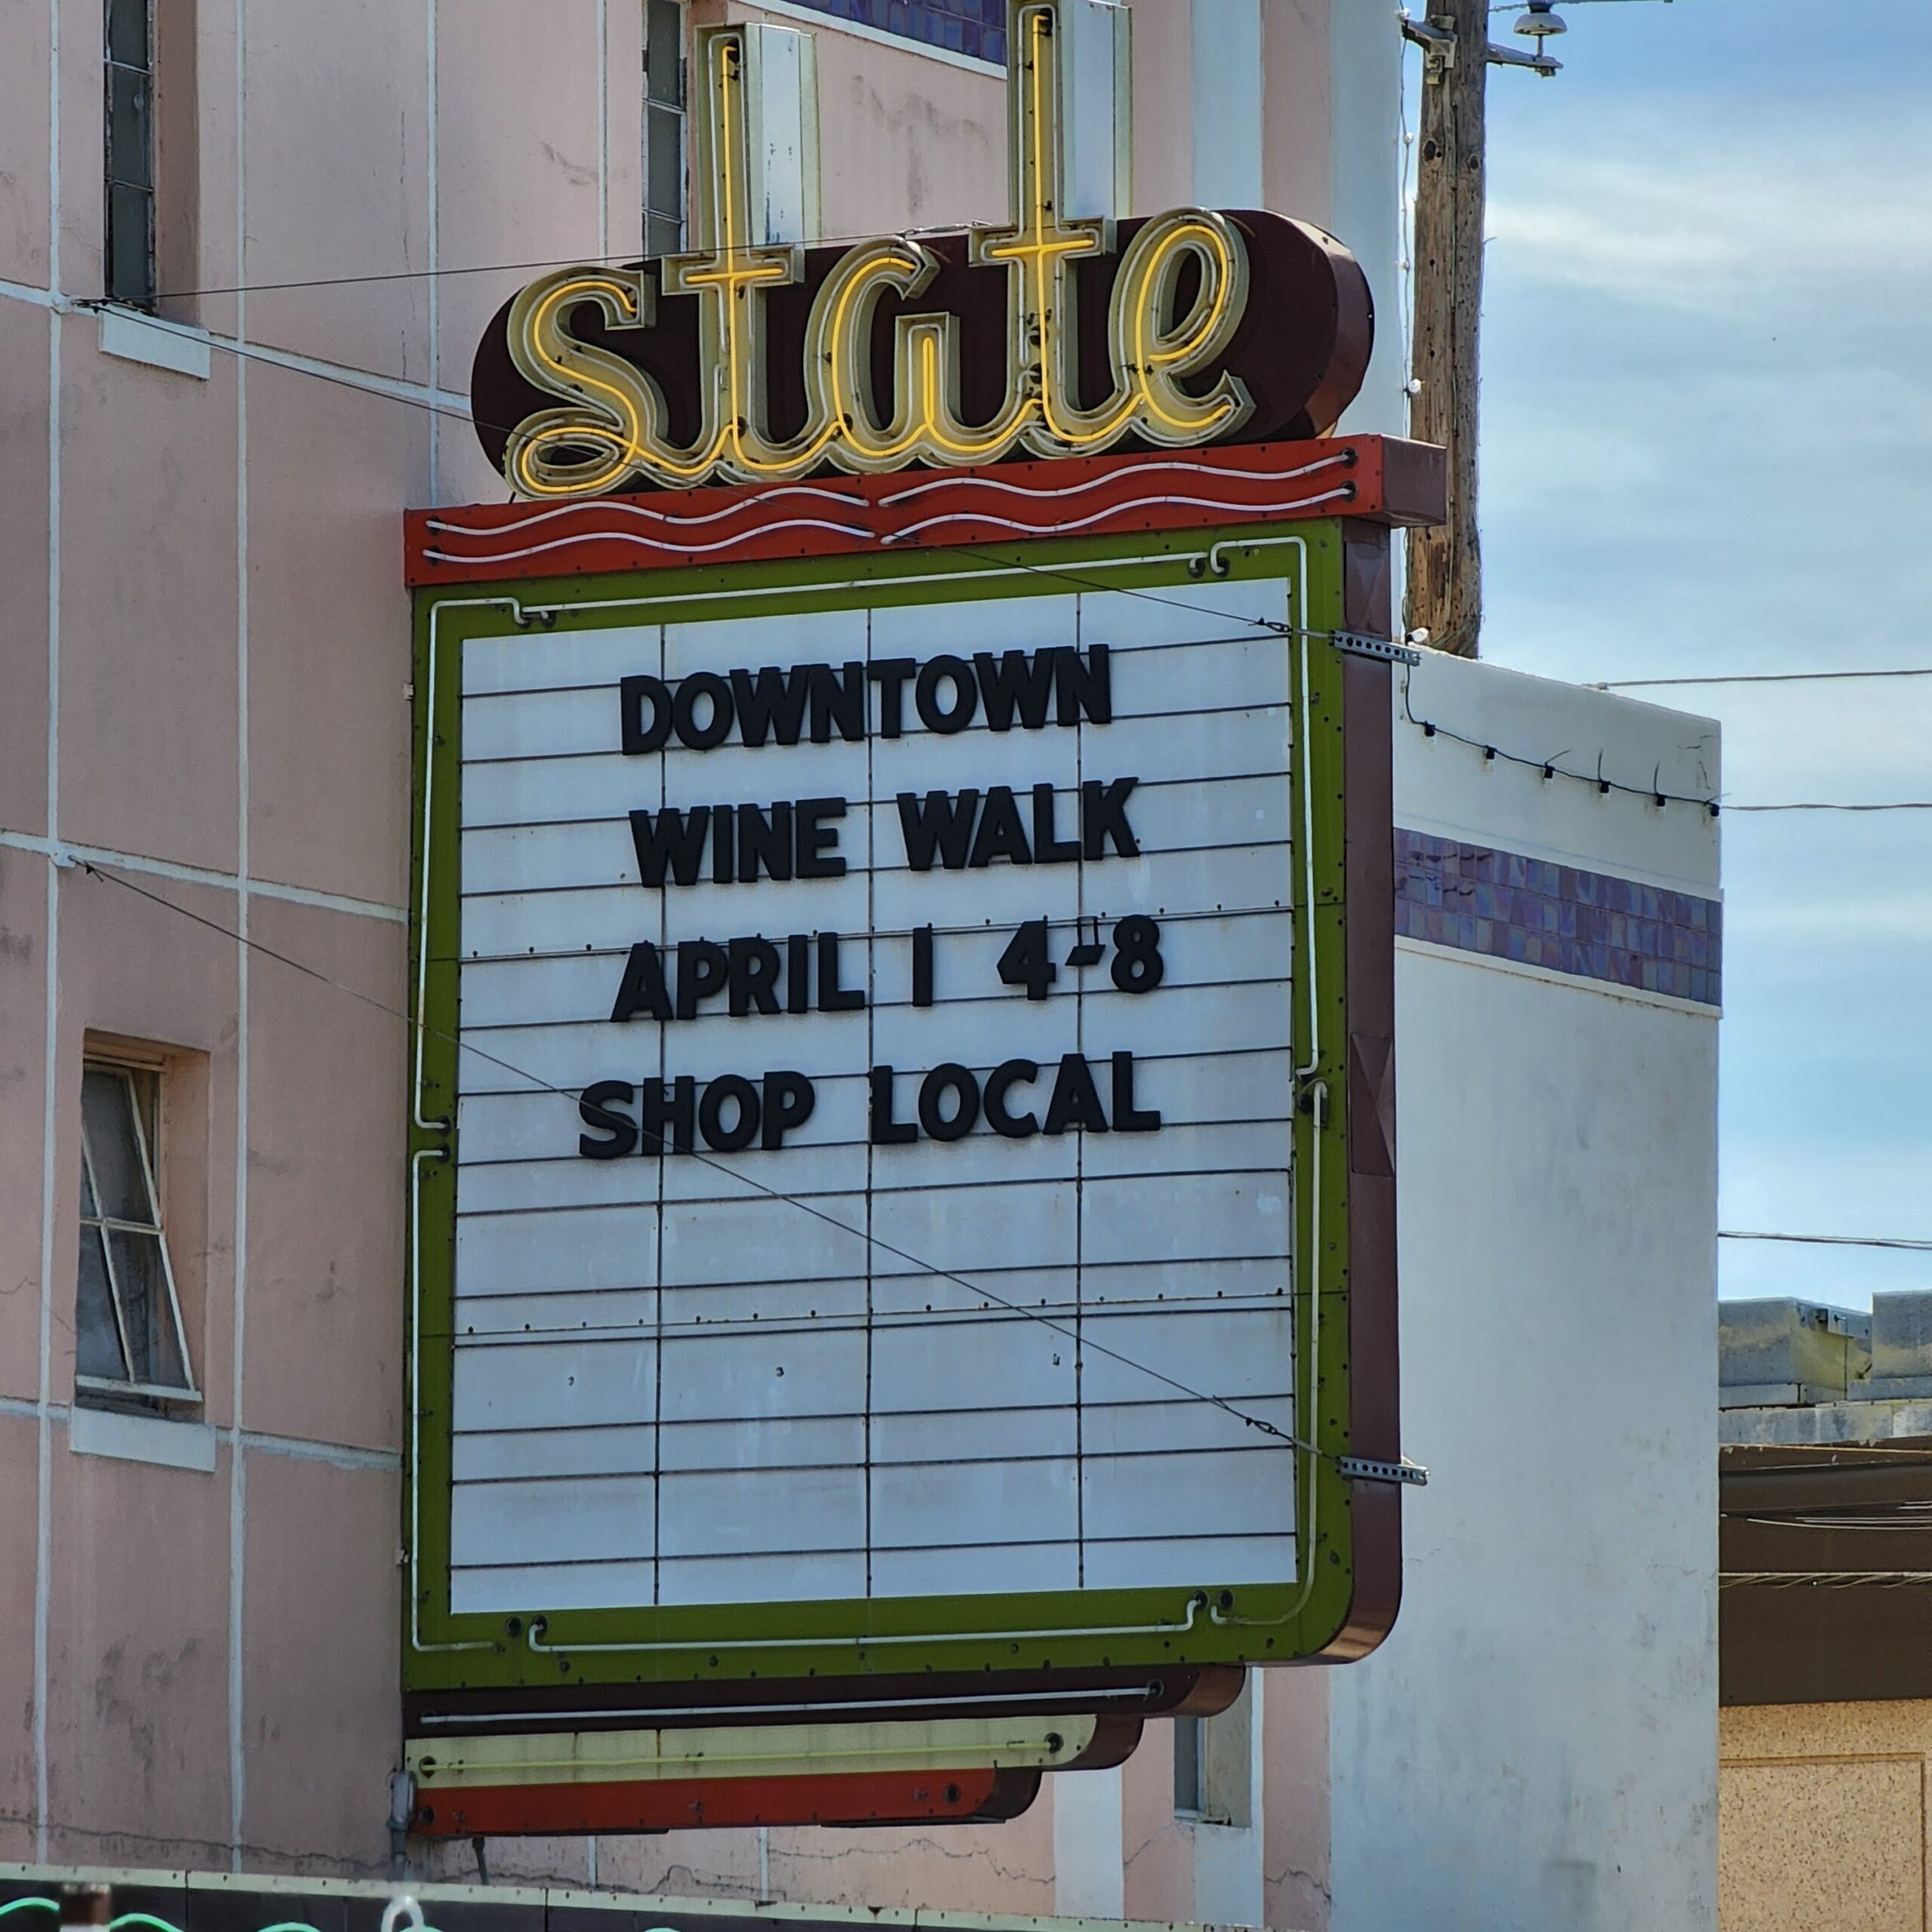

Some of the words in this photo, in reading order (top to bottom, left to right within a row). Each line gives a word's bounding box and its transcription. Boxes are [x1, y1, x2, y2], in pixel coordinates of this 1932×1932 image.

[620, 644, 1112, 755] DOWNTOWN
[629, 797, 847, 888] WINE
[897, 777, 1141, 872] WALK
[609, 932, 866, 1023] APRIL
[996, 914, 1164, 1001] 4-8
[579, 1071, 815, 1160] SHOP
[869, 1051, 1161, 1145] LOCAL
